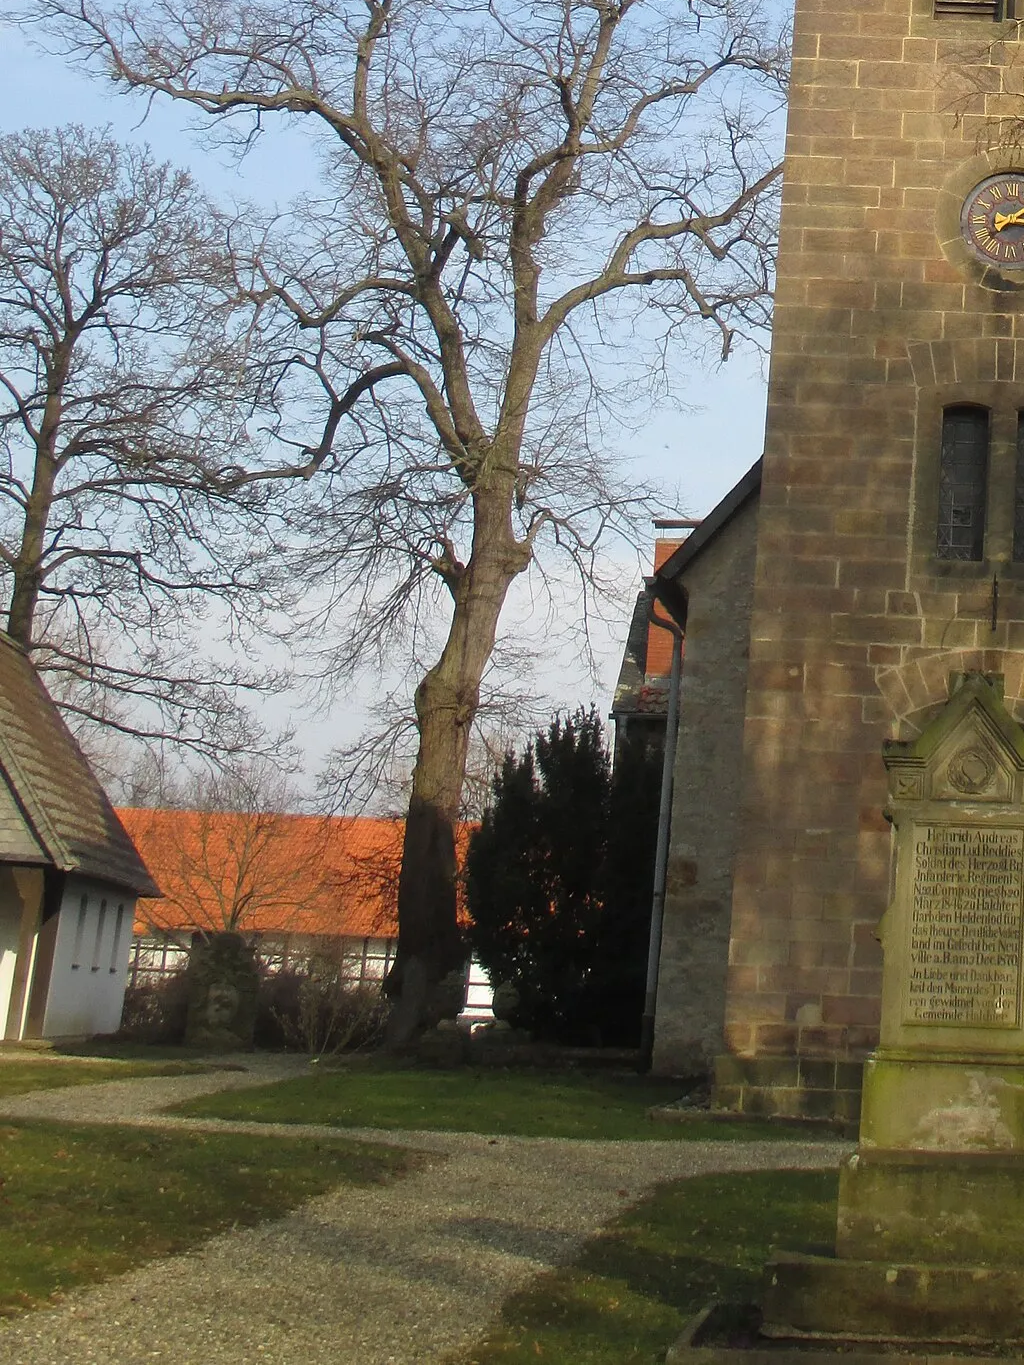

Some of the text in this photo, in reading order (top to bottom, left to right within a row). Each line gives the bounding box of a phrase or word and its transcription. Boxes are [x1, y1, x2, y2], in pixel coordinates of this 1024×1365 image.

[989, 186, 1002, 200] XI
[1005, 183, 1019, 197] XII
[977, 199, 991, 210] X
[972, 214, 986, 224] IX
[974, 227, 991, 246] VIII
[985, 240, 1000, 256] VII
[1004, 245, 1017, 259] VI
[927, 828, 1019, 844] Heinrich Andreas
[916, 841, 963, 856] Christian
[982, 843, 1022, 857] Beddies
[915, 856, 947, 870] Soldat
[948, 857, 966, 870] des
[968, 870, 1020, 886] Regiments
[913, 896, 941, 910] März
[934, 911, 952, 923] den
[954, 912, 1003, 925] Heldentod
[911, 924, 929, 936] das
[911, 936, 931, 950] land
[932, 938, 945, 950] im
[981, 938, 996, 953] bei
[949, 970, 968, 981] und
[927, 982, 943, 994] den
